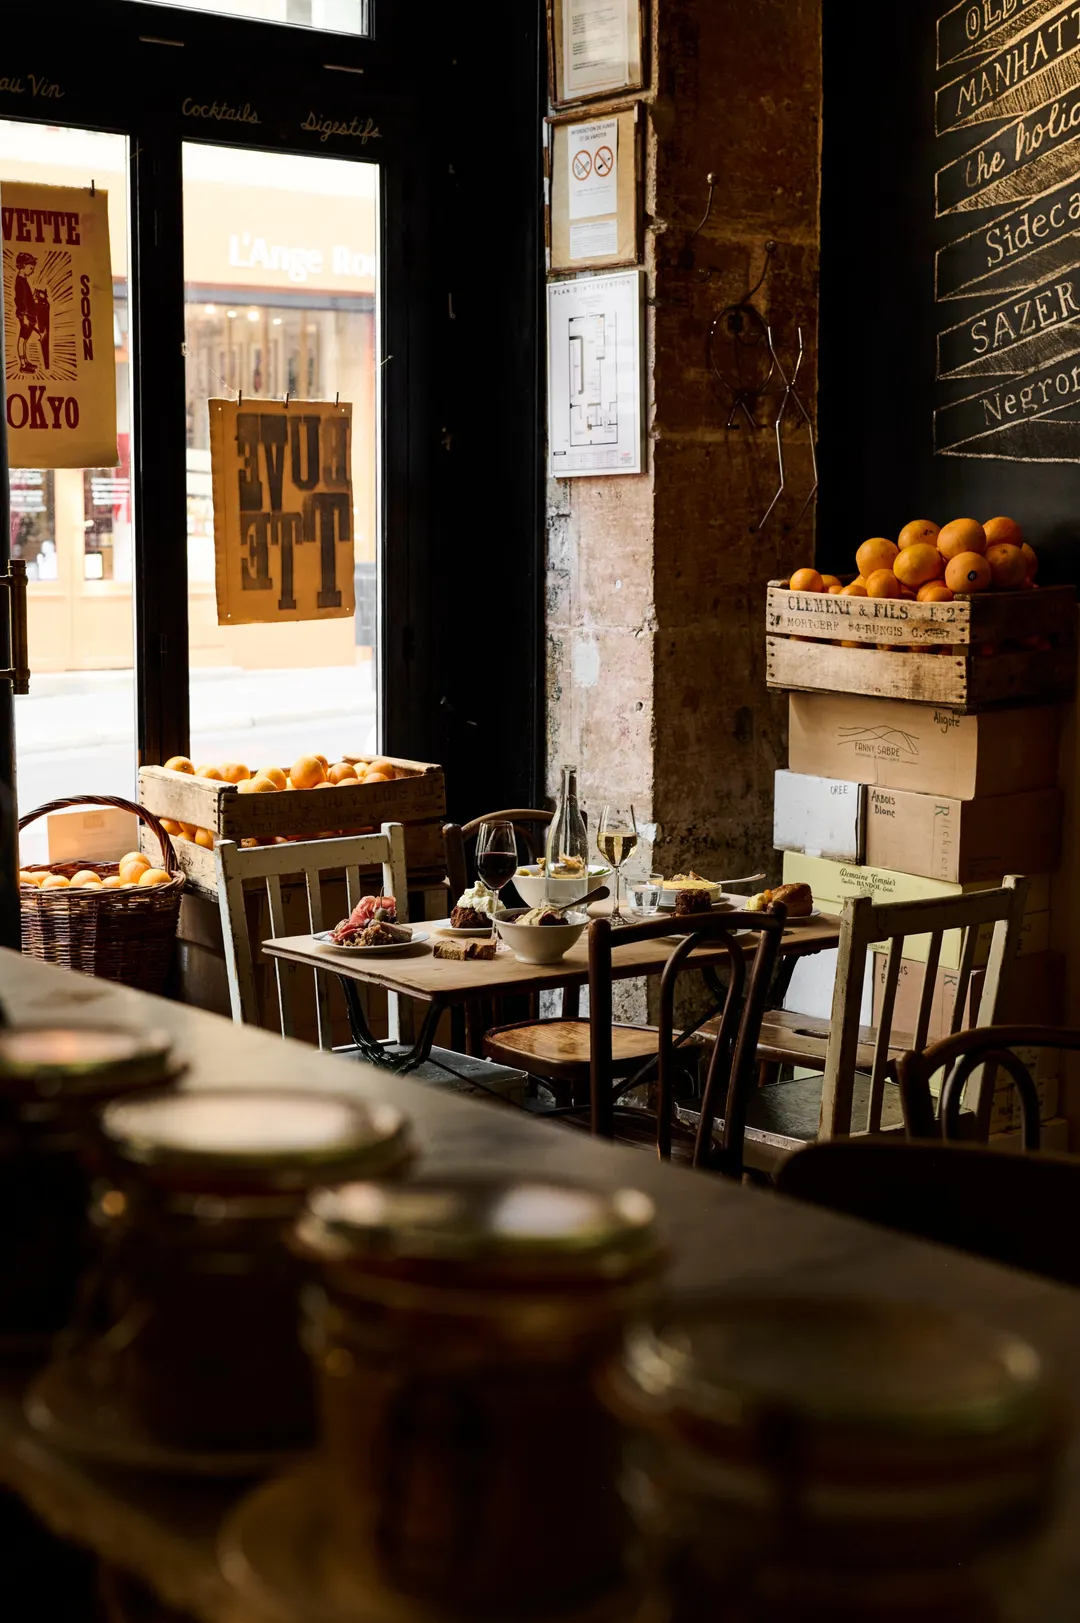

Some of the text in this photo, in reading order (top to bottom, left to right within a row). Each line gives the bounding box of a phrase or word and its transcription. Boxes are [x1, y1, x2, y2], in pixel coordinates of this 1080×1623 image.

[28, 73, 67, 99] Vin
[181, 97, 263, 125] Cocktails
[300, 110, 384, 145] Digestifs
[966, 150, 1006, 188] the
[985, 192, 1080, 267] Sideca
[230, 230, 323, 283] L'Ange
[80, 274, 94, 361] SOON
[971, 281, 1080, 353] SAZER
[788, 596, 852, 616] CLEMENT
[858, 603, 869, 619] &
[873, 603, 909, 620] FILS
[854, 741, 900, 758] FANNY SABRE
[874, 804, 896, 818] Blanc
